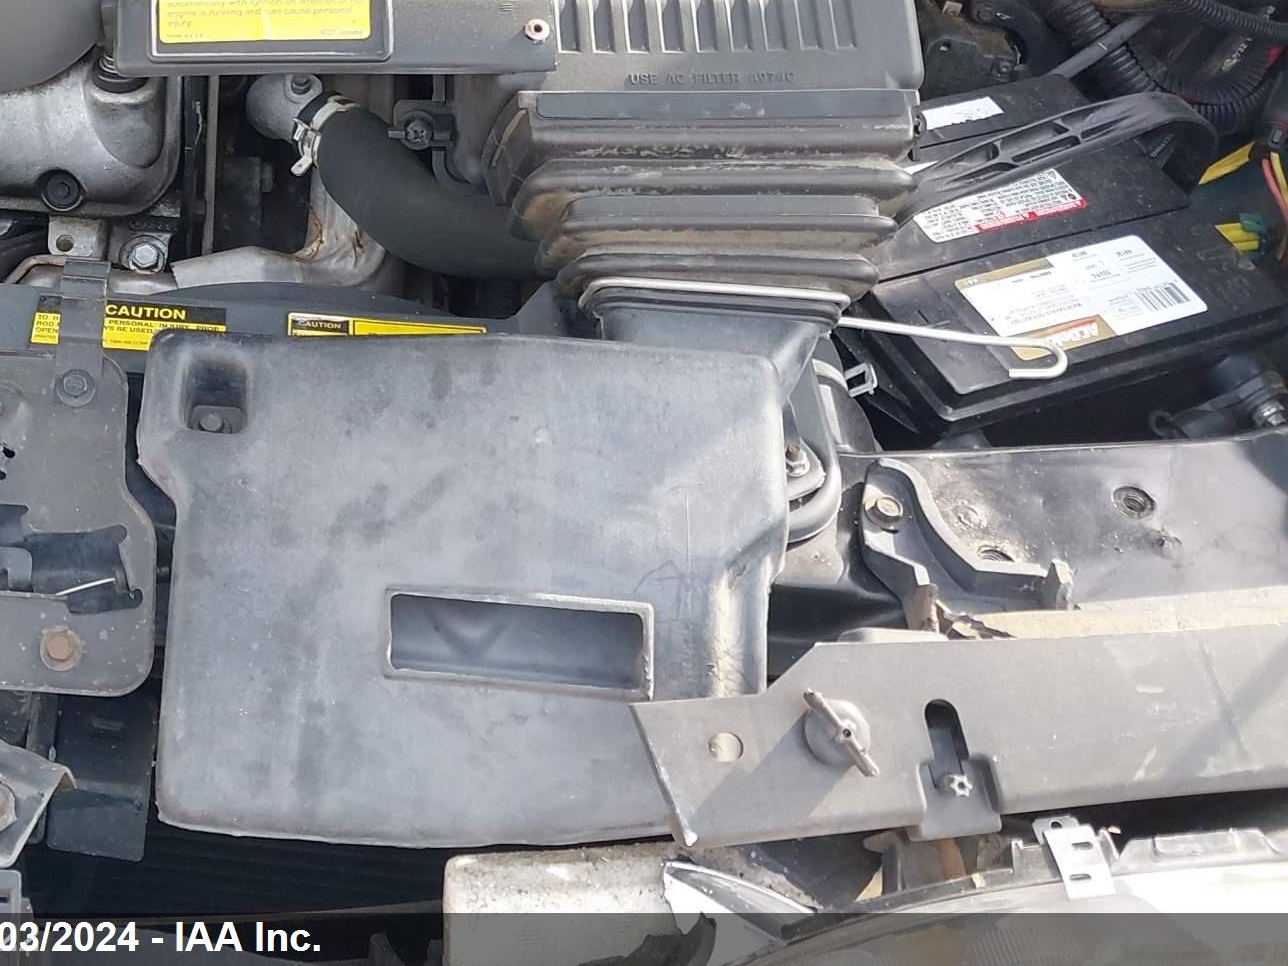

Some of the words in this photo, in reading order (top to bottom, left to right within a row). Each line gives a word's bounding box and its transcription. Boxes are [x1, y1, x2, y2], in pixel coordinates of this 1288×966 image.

[229, 0, 248, 8] with
[167, 11, 197, 20] engine
[209, 9, 243, 18] running
[244, 6, 262, 16] and
[264, 8, 282, 16] can
[283, 8, 312, 16] cause
[312, 5, 353, 18] personal
[628, 73, 657, 84] USE
[666, 73, 685, 84] AC
[692, 73, 740, 84] FILTER
[104, 303, 187, 321] CAUTION
[37, 313, 49, 321] TO
[108, 319, 155, 328] PERSONAL
[298, 320, 342, 330] CAUTION
[118, 325, 129, 333] BE
